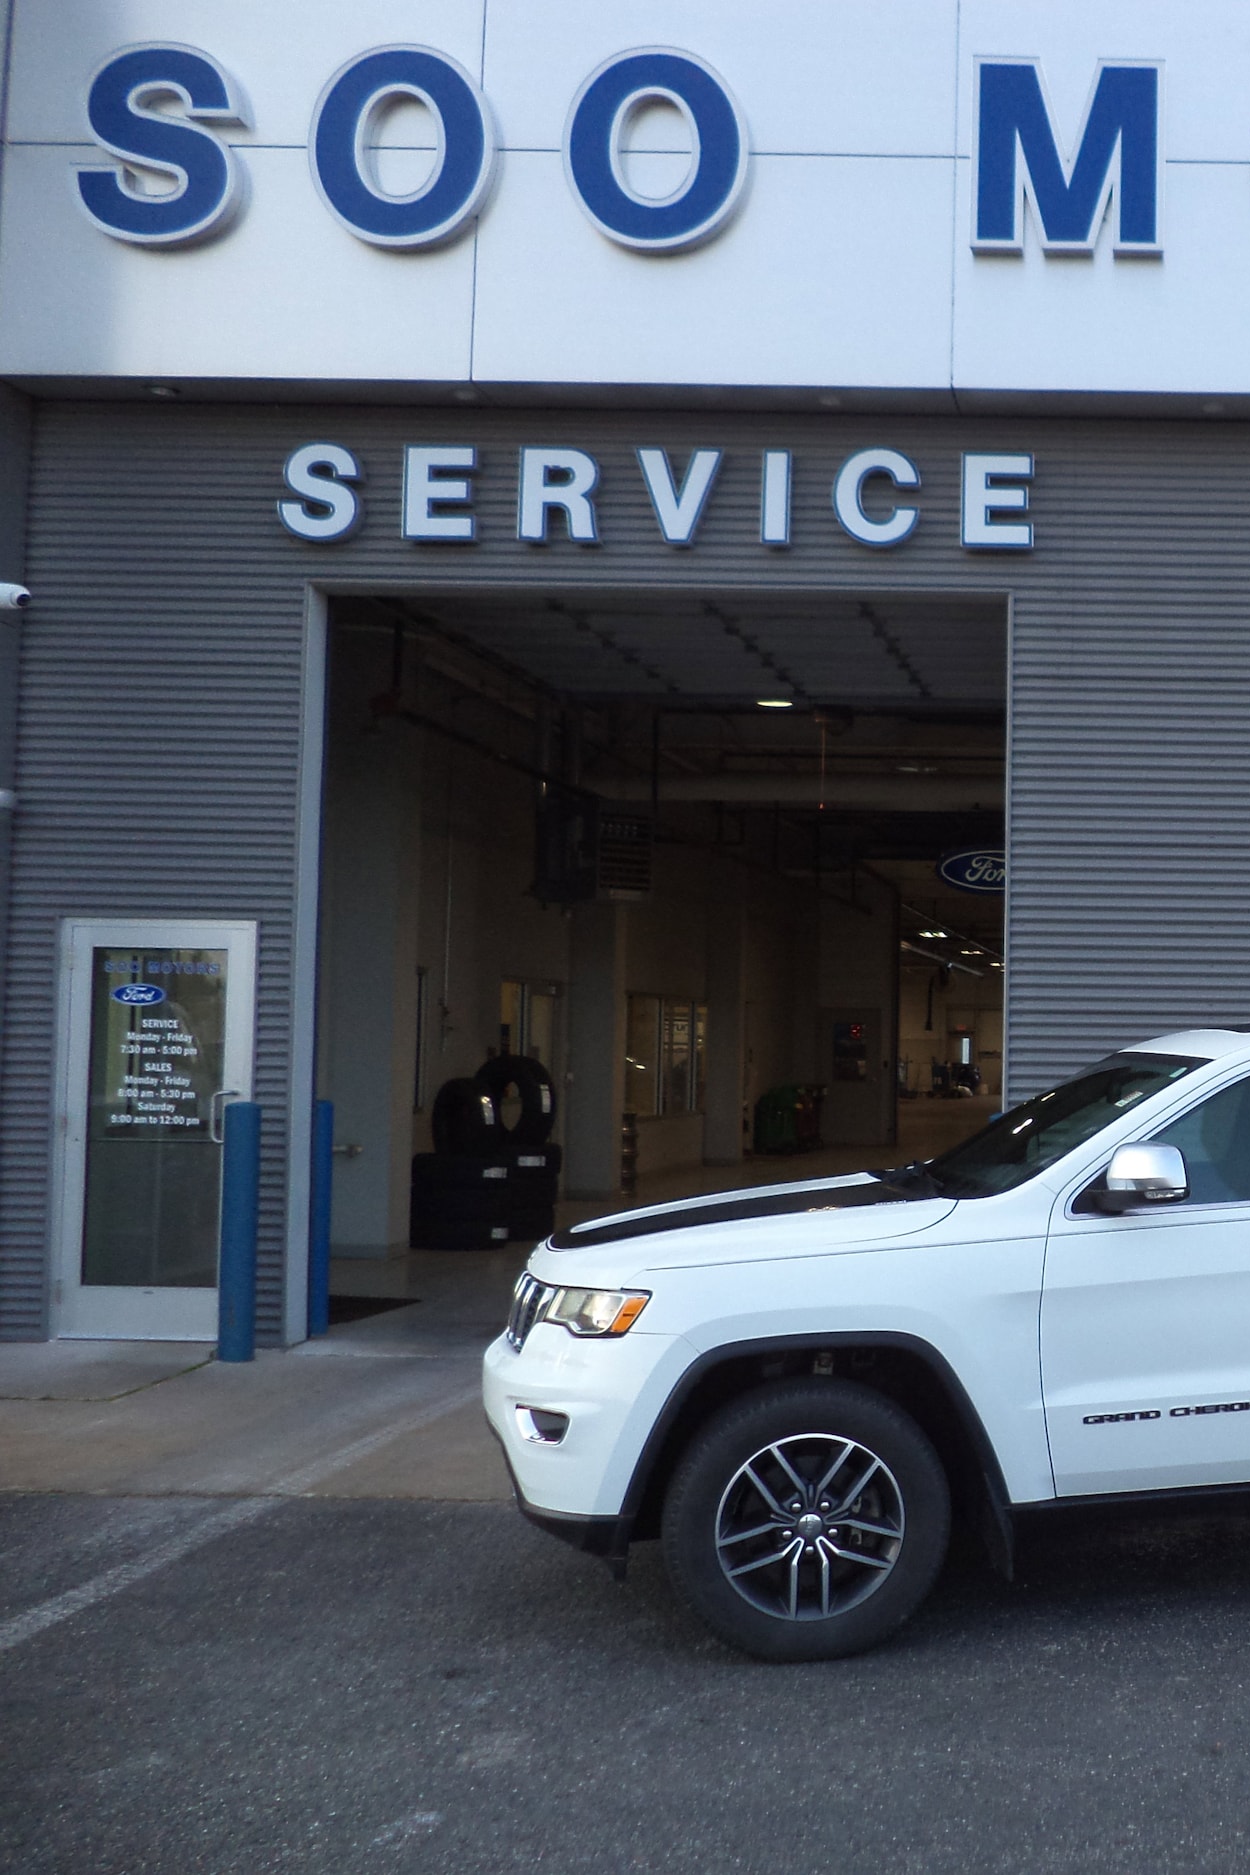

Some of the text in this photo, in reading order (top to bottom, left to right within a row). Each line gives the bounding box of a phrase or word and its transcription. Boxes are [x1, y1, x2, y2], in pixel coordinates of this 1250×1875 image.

[74, 42, 750, 252] SOO
[277, 442, 1035, 551] SERVICE
[965, 856, 1005, 882] For
[105, 960, 219, 975] SOO MOTORS
[122, 987, 155, 1001] Ford
[142, 1019, 179, 1028] SERVICE
[127, 1032, 160, 1042] Monday
[167, 1033, 193, 1043] Friday
[121, 1045, 140, 1054] 7:30
[162, 1046, 182, 1054] 5:00
[183, 1048, 197, 1056] pm
[144, 1063, 172, 1072] SALES
[124, 1076, 158, 1086] Monday
[165, 1076, 190, 1087] Friday
[138, 1102, 175, 1112] Saturday
[149, 1116, 157, 1124] to
[160, 1116, 184, 1124] 12:00
[185, 1118, 200, 1126] pm
[1083, 1410, 1161, 1425] GRAND
